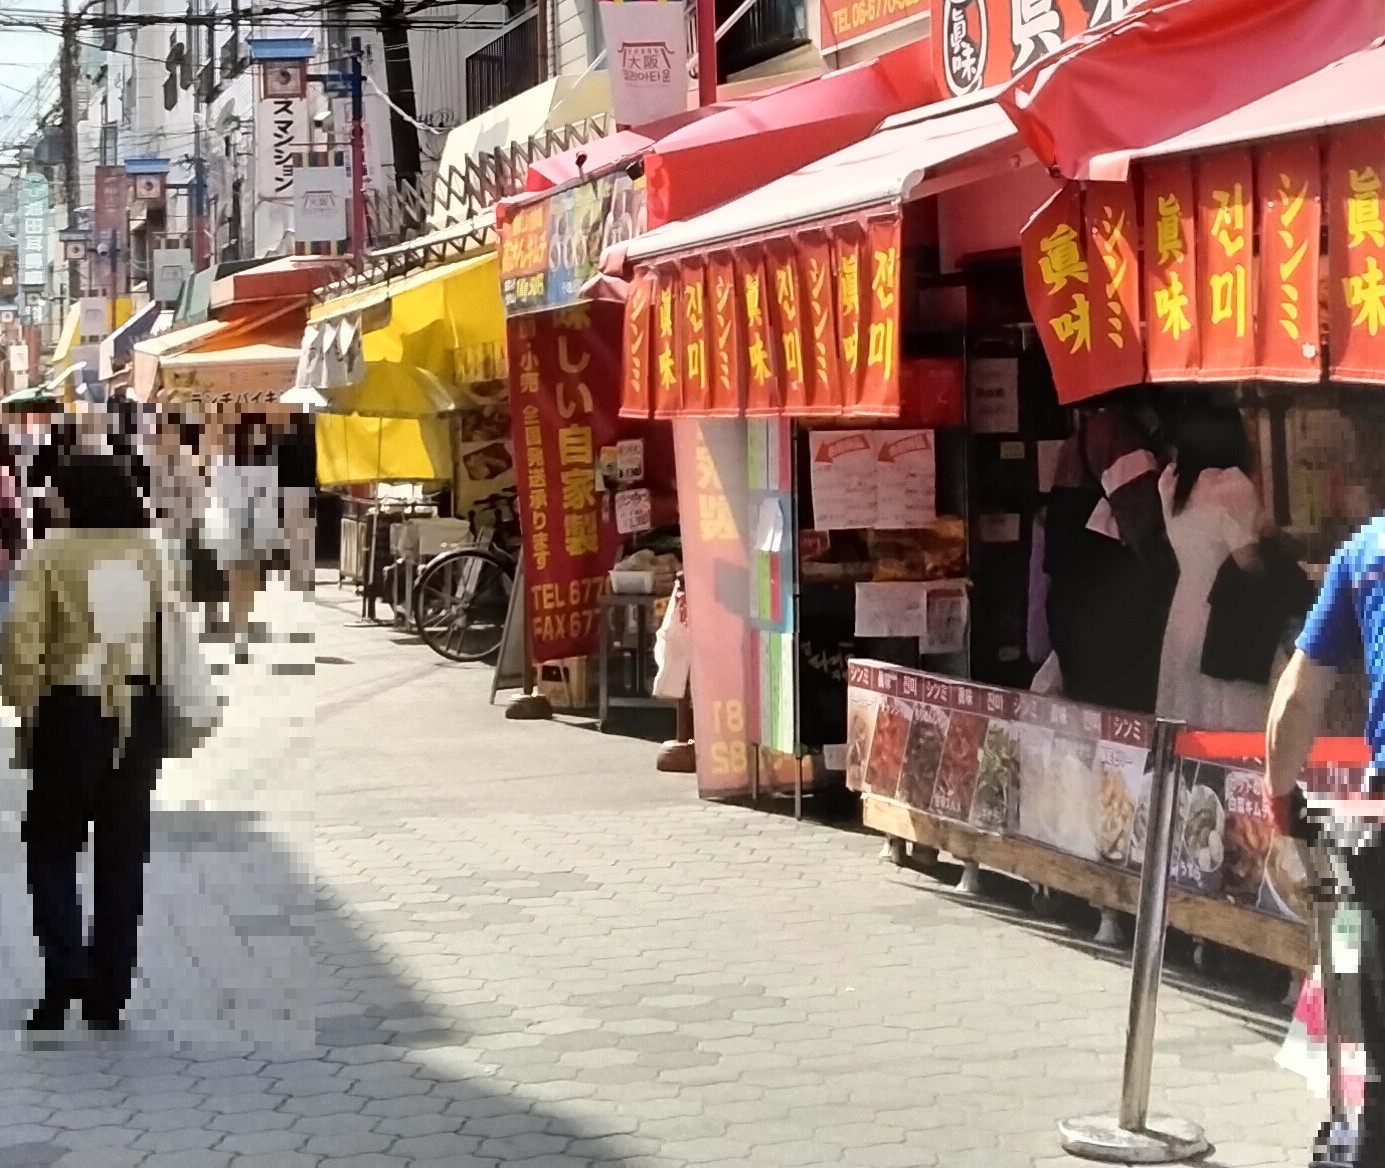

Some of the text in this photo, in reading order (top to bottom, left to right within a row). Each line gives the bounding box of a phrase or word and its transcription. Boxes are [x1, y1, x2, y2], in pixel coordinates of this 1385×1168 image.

[832, 7, 851, 36] TEL
[1208, 181, 1247, 340] 진미
[1276, 171, 1311, 342] シンミ
[867, 247, 896, 382] 진미
[530, 583, 565, 610] TEL
[533, 614, 566, 641] FAX
[1113, 717, 1142, 741] シンミ
